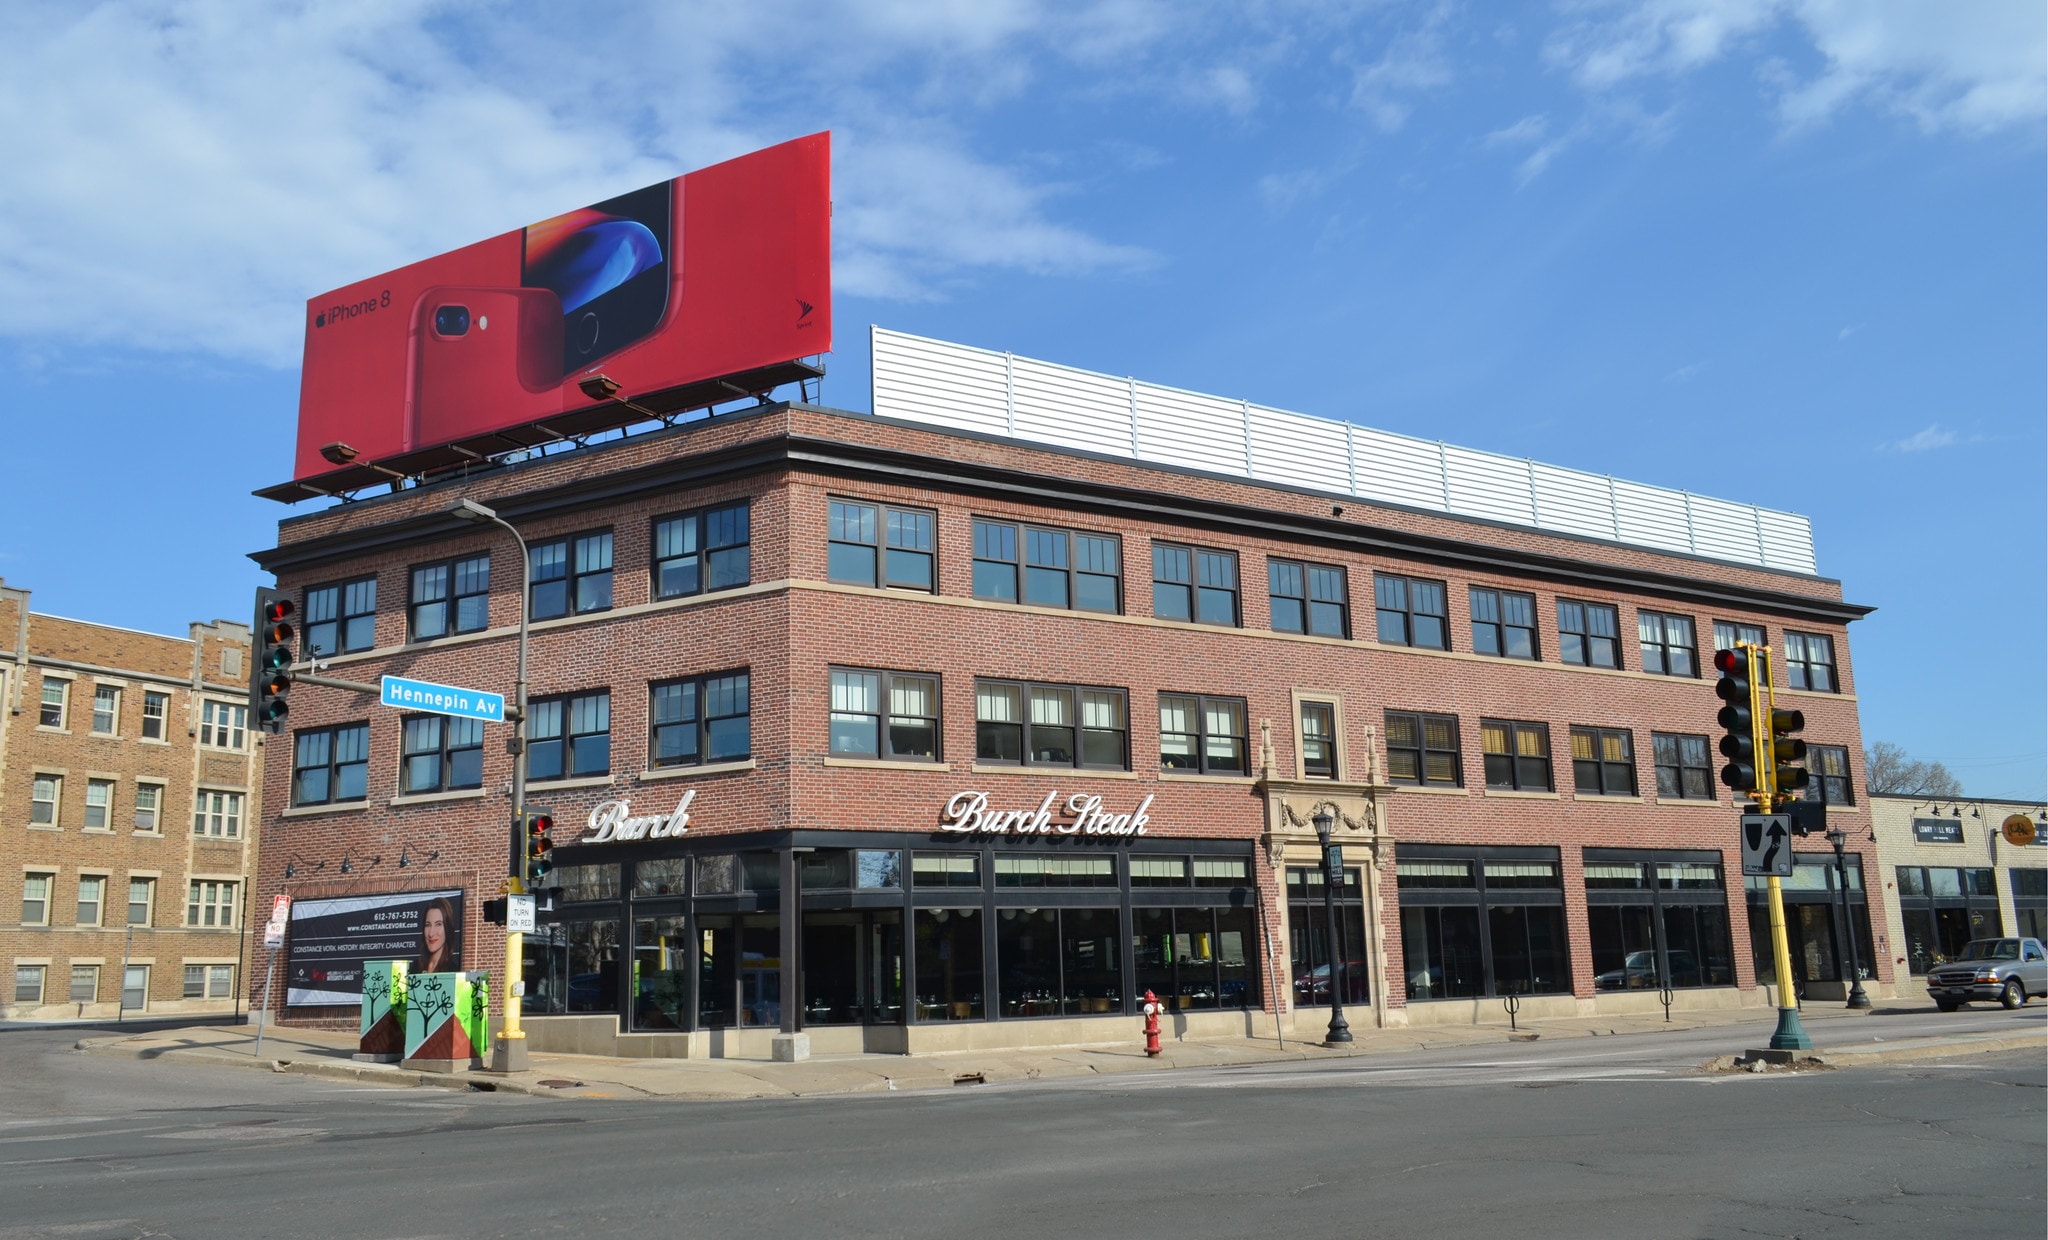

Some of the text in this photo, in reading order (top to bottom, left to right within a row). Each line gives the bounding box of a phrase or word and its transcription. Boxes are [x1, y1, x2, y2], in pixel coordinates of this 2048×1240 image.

[328, 289, 391, 325] iPhone 8
[390, 684, 496, 714] Hennepin Av
[581, 789, 697, 843] Burch
[940, 789, 1155, 835] Burch Steak
[516, 898, 526, 906] NO
[374, 911, 418, 920] 612-767-5752
[514, 908, 529, 916] TURN
[510, 919, 518, 927] ON
